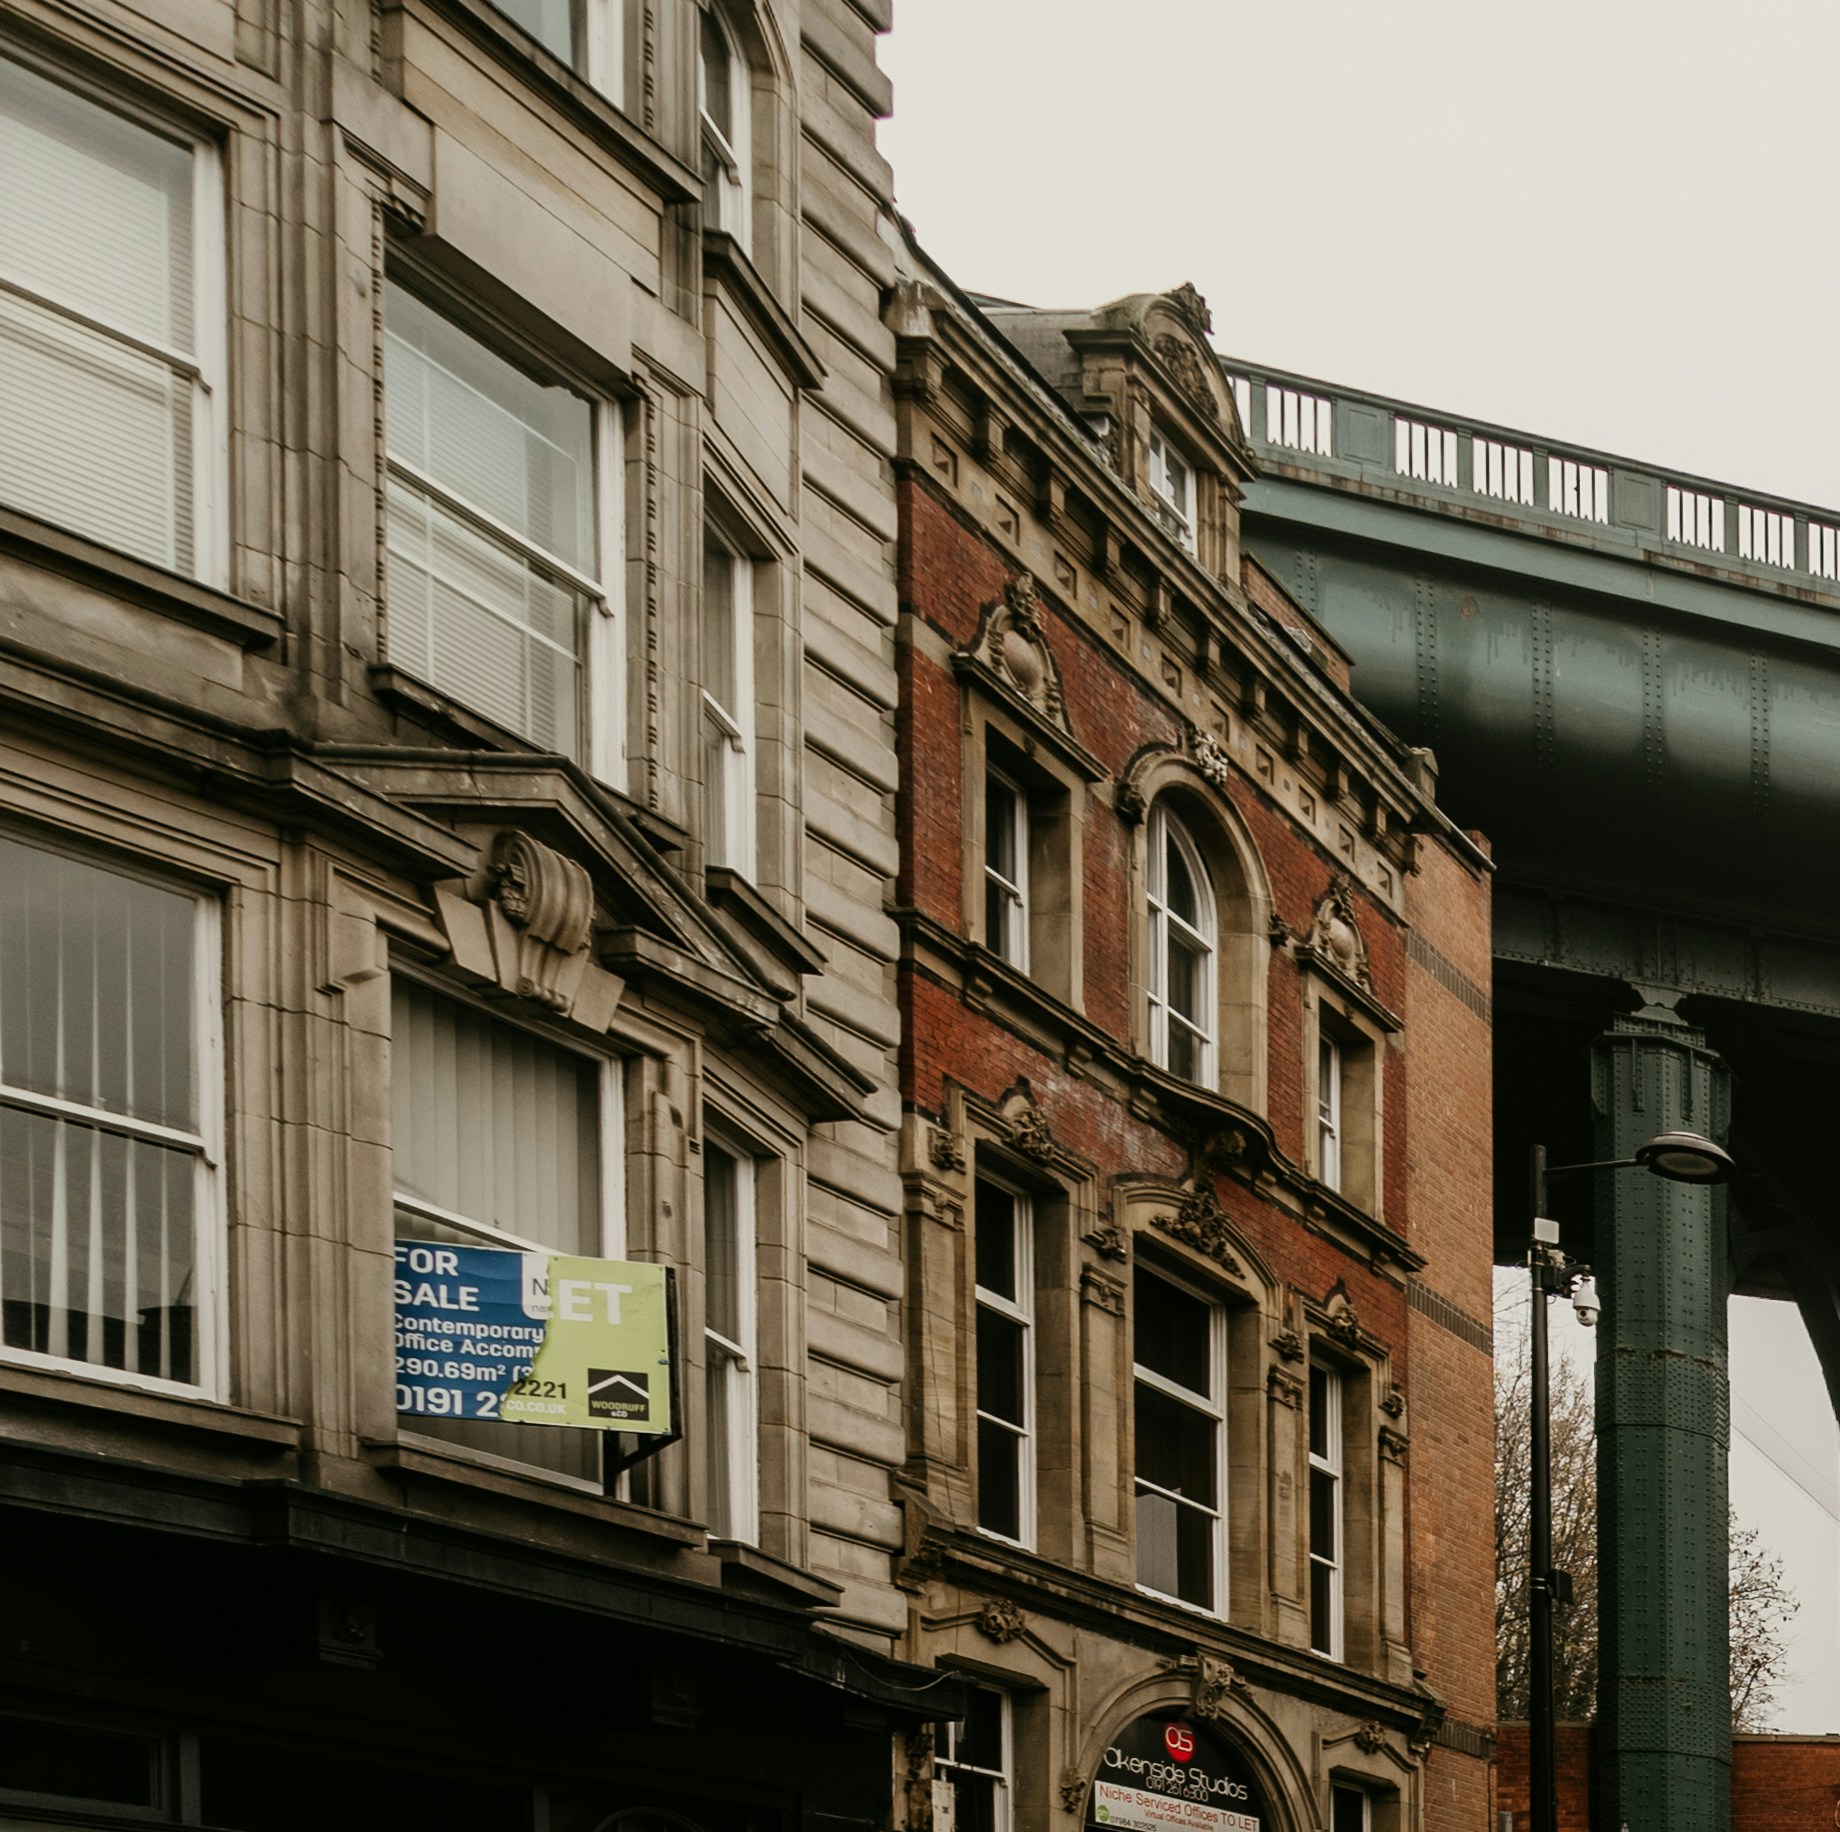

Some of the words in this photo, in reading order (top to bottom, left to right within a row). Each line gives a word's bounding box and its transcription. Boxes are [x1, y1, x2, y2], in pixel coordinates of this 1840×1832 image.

[394, 1280, 480, 1312] SALE
[396, 1384, 463, 1415] 0191
[591, 1401, 646, 1413] WOODRUFF
[1189, 1768, 1248, 1801] Studios
[1099, 1784, 1133, 1804] Niche
[1135, 1792, 1181, 1815] Serviced
[1184, 1804, 1219, 1823] Offices
[1221, 1812, 1236, 1827] TO
[1238, 1816, 1258, 1832] LET
